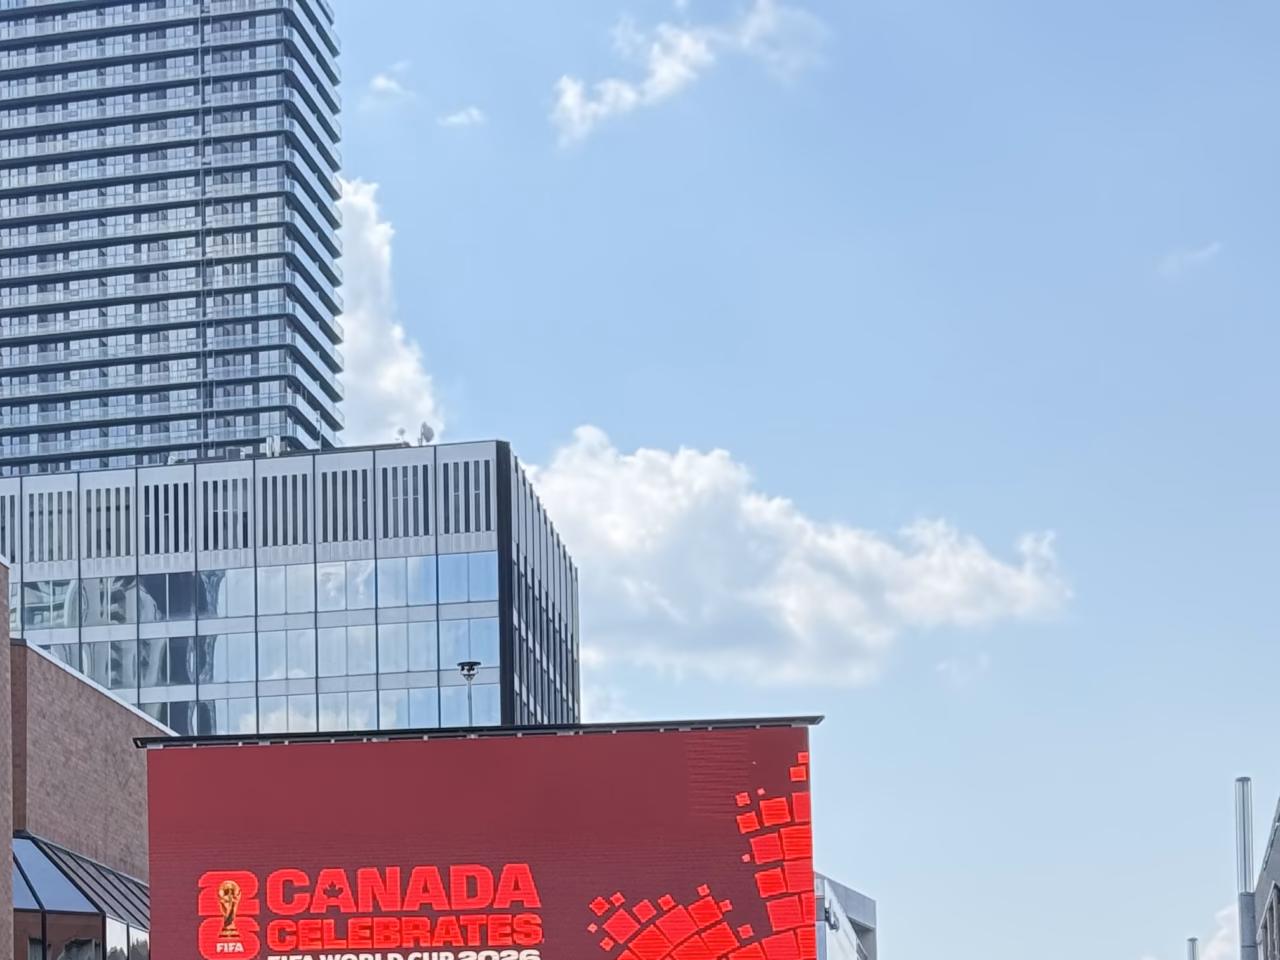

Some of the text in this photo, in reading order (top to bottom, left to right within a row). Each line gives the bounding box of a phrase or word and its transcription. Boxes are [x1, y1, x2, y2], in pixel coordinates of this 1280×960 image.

[267, 863, 542, 915] CANADA
[216, 942, 245, 953] FIFA
[268, 913, 543, 952] CELEBRATES
